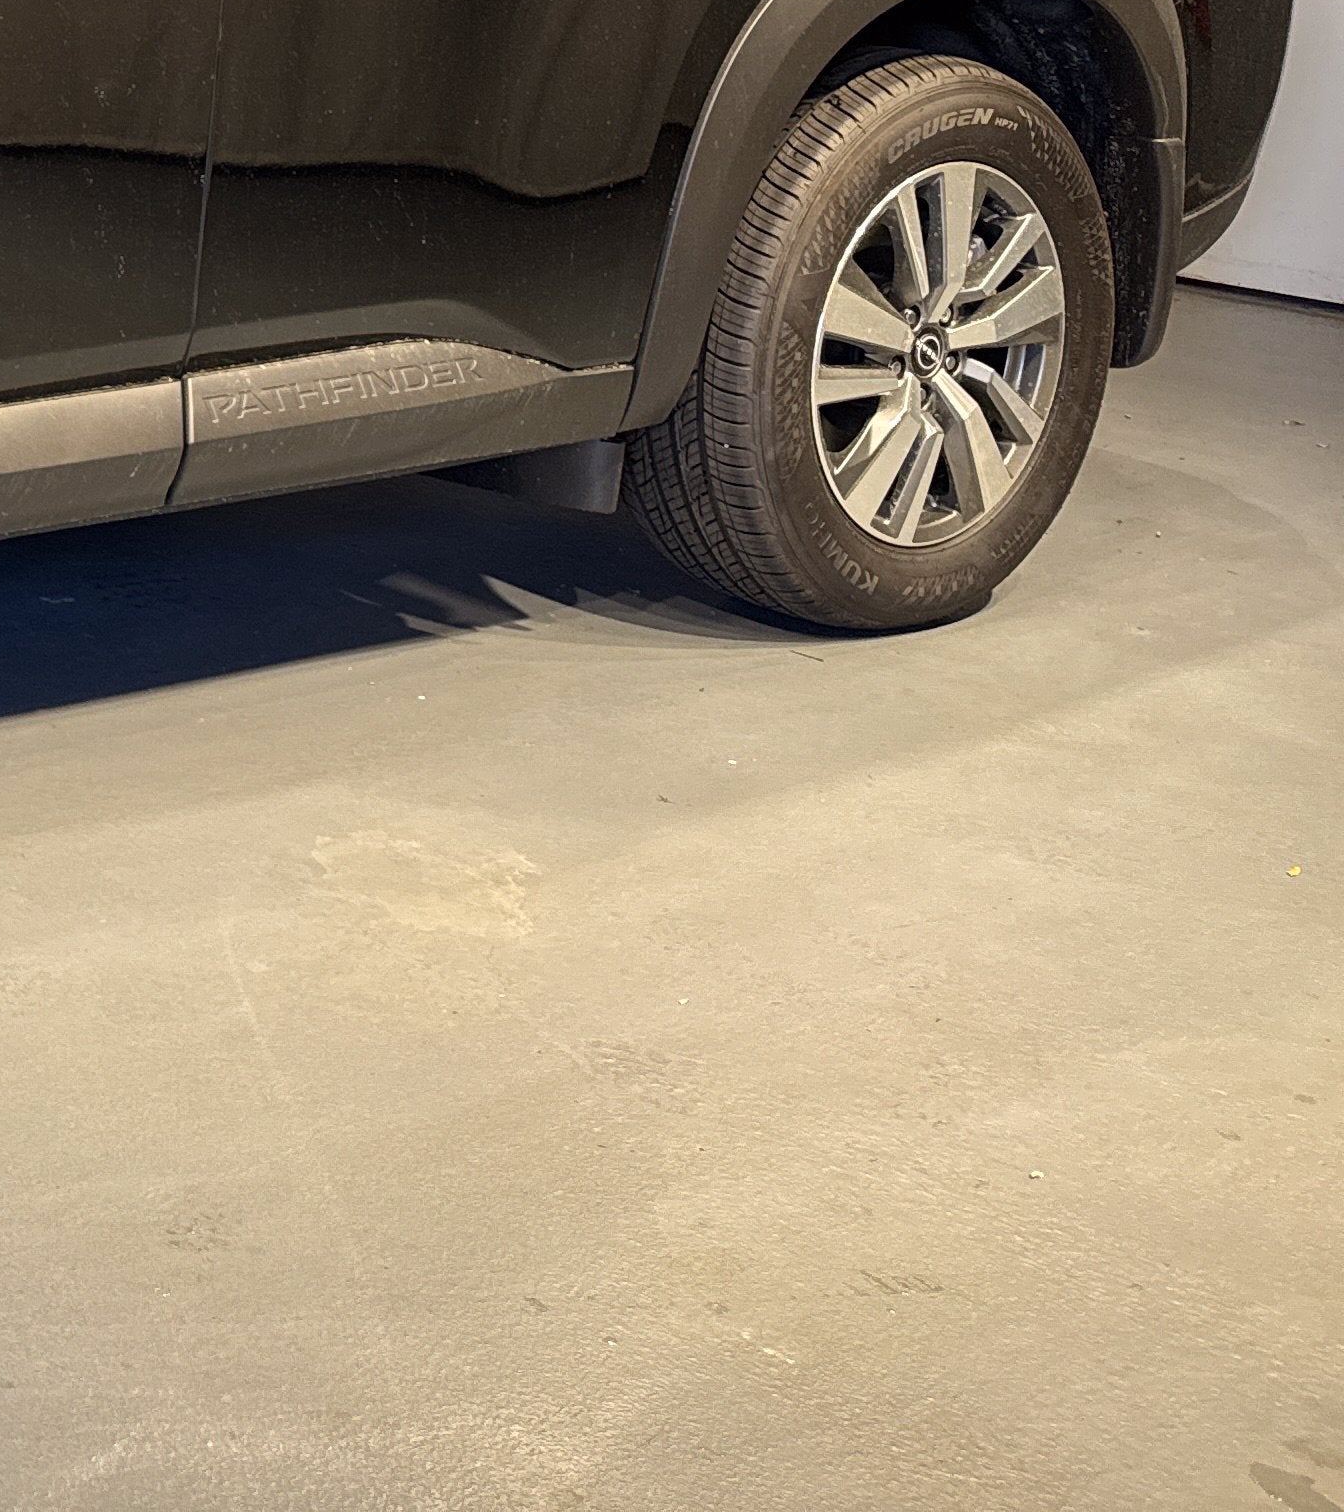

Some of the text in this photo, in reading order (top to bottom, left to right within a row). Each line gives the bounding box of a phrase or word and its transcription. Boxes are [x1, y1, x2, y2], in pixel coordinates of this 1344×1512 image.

[888, 107, 995, 165] CRUGEN
[994, 117, 1019, 131] HP71
[202, 356, 485, 424] PATHFINDER
